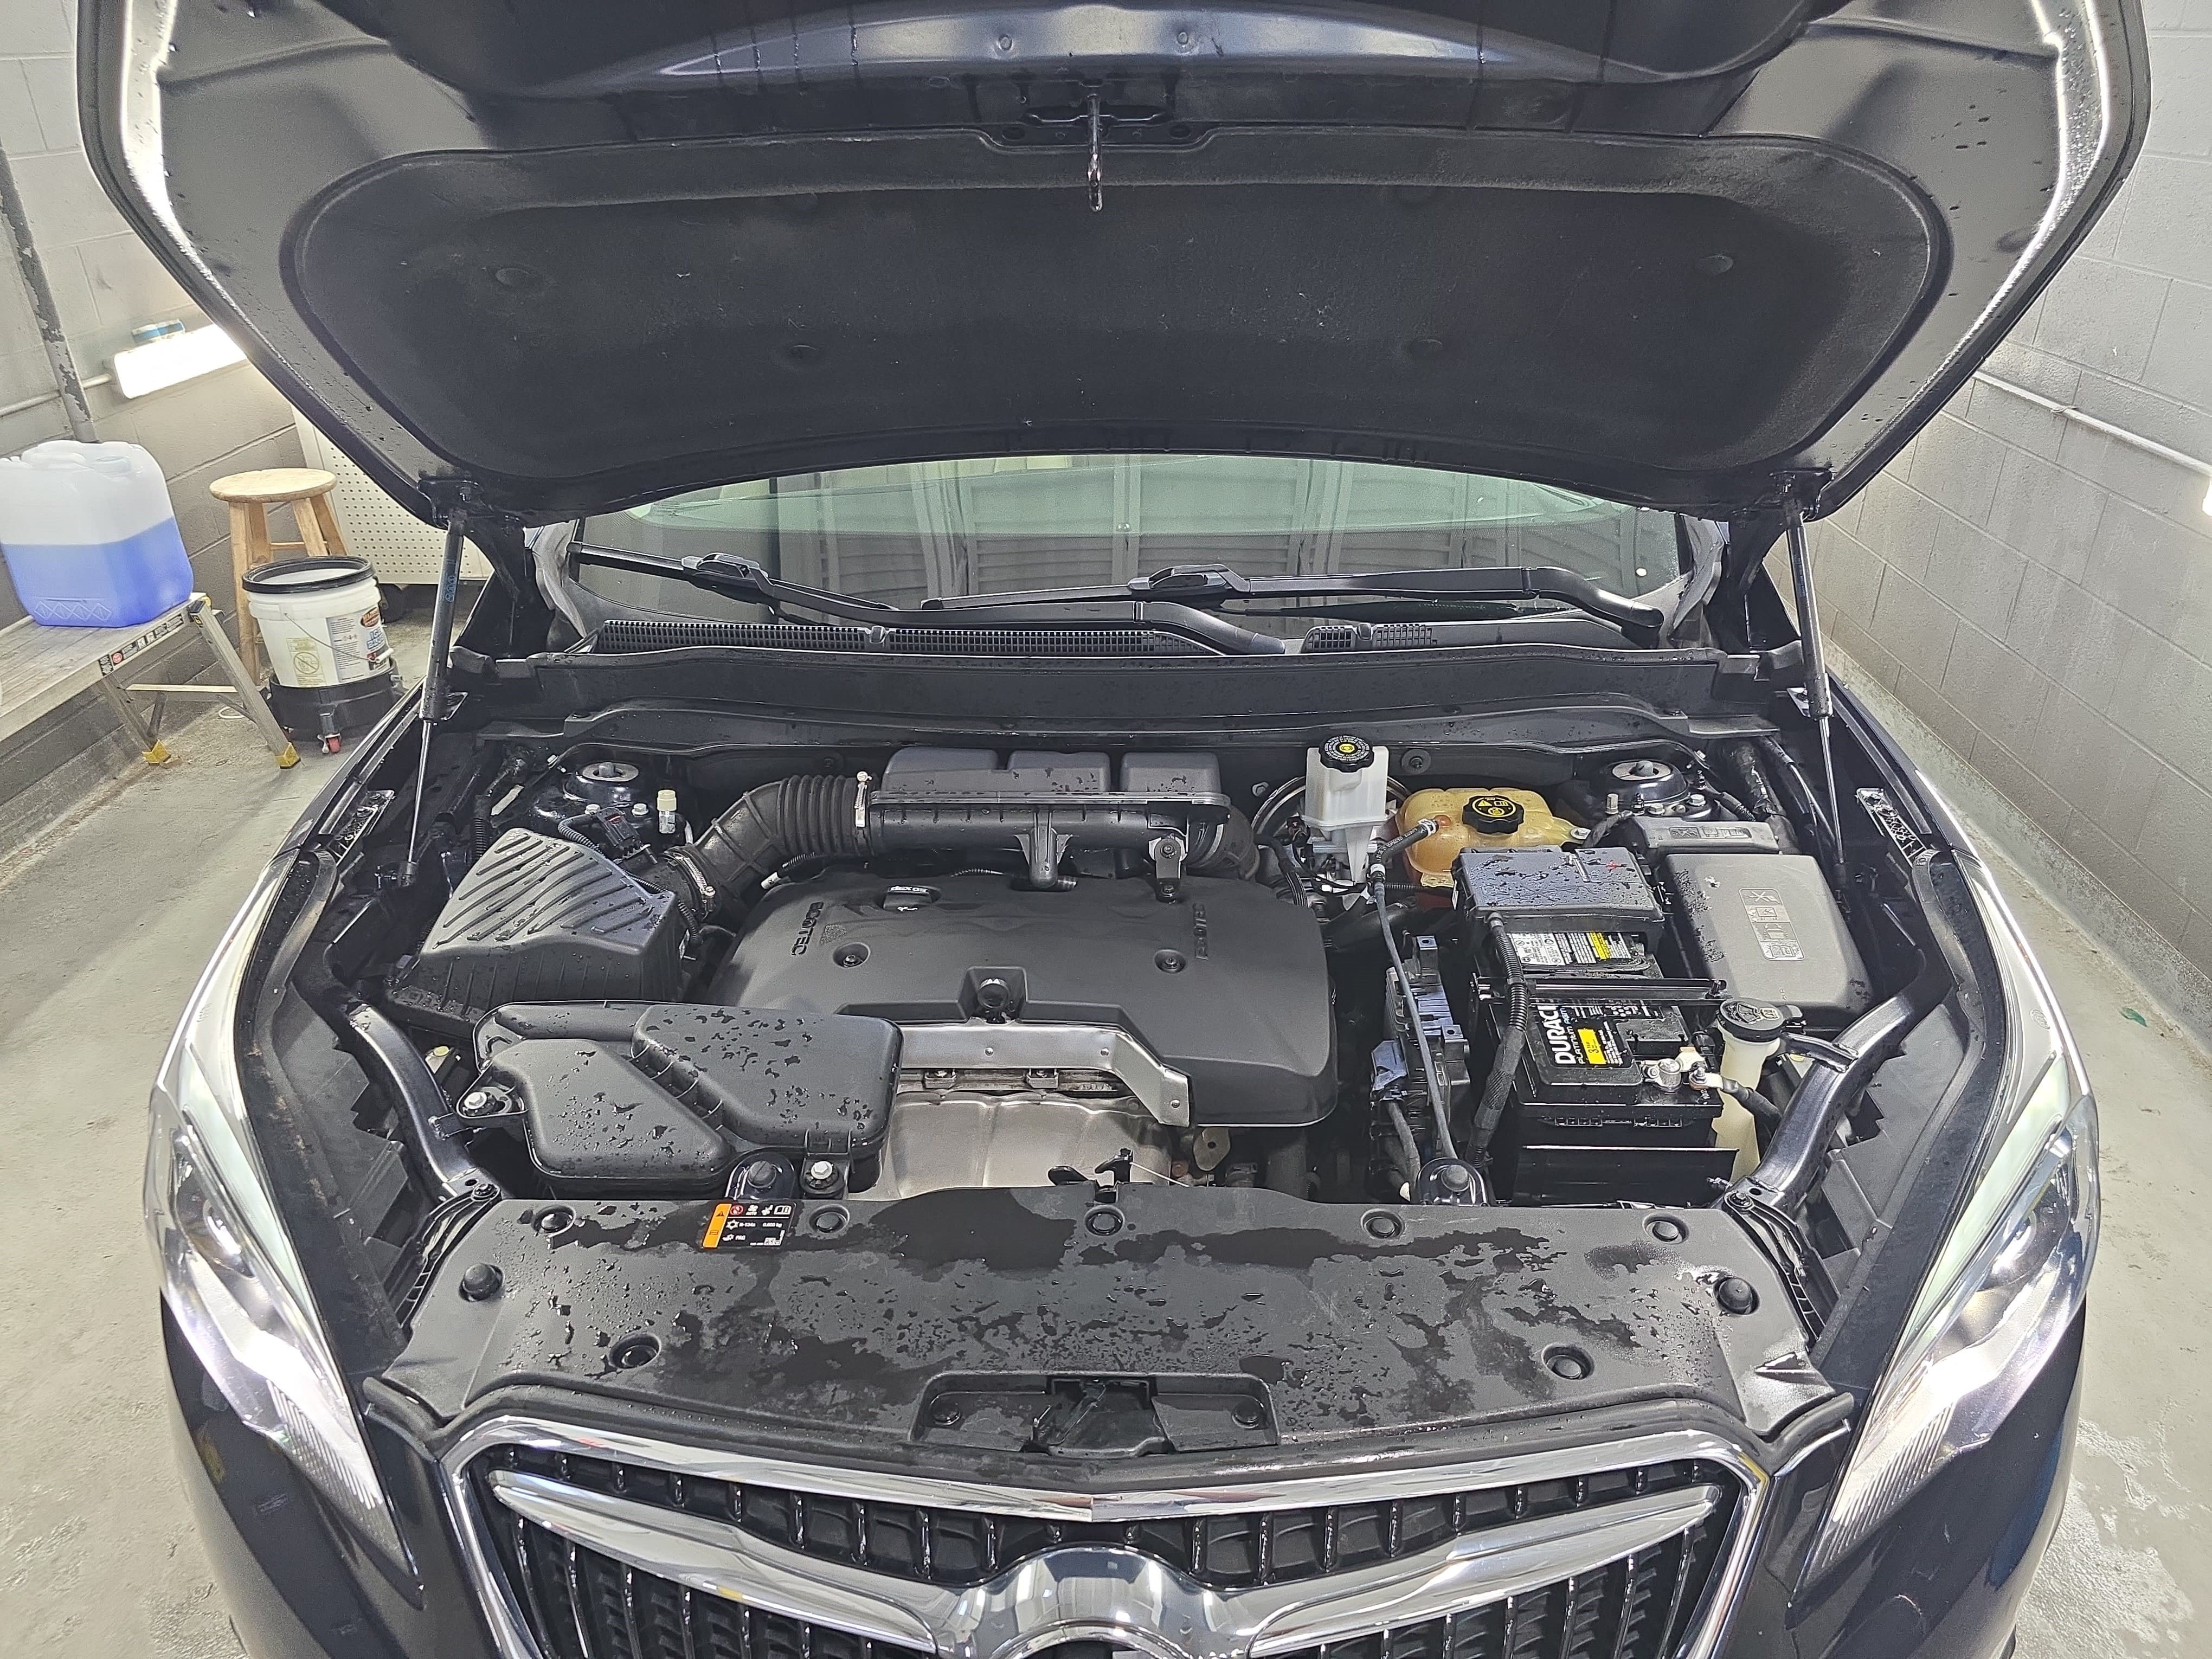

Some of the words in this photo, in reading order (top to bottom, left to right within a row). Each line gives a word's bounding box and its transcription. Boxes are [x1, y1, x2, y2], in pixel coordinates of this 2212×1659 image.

[790, 901, 825, 956] ECOTEC
[1538, 1005, 1576, 1064] DURAC
[1560, 1008, 1571, 1024] AGM
